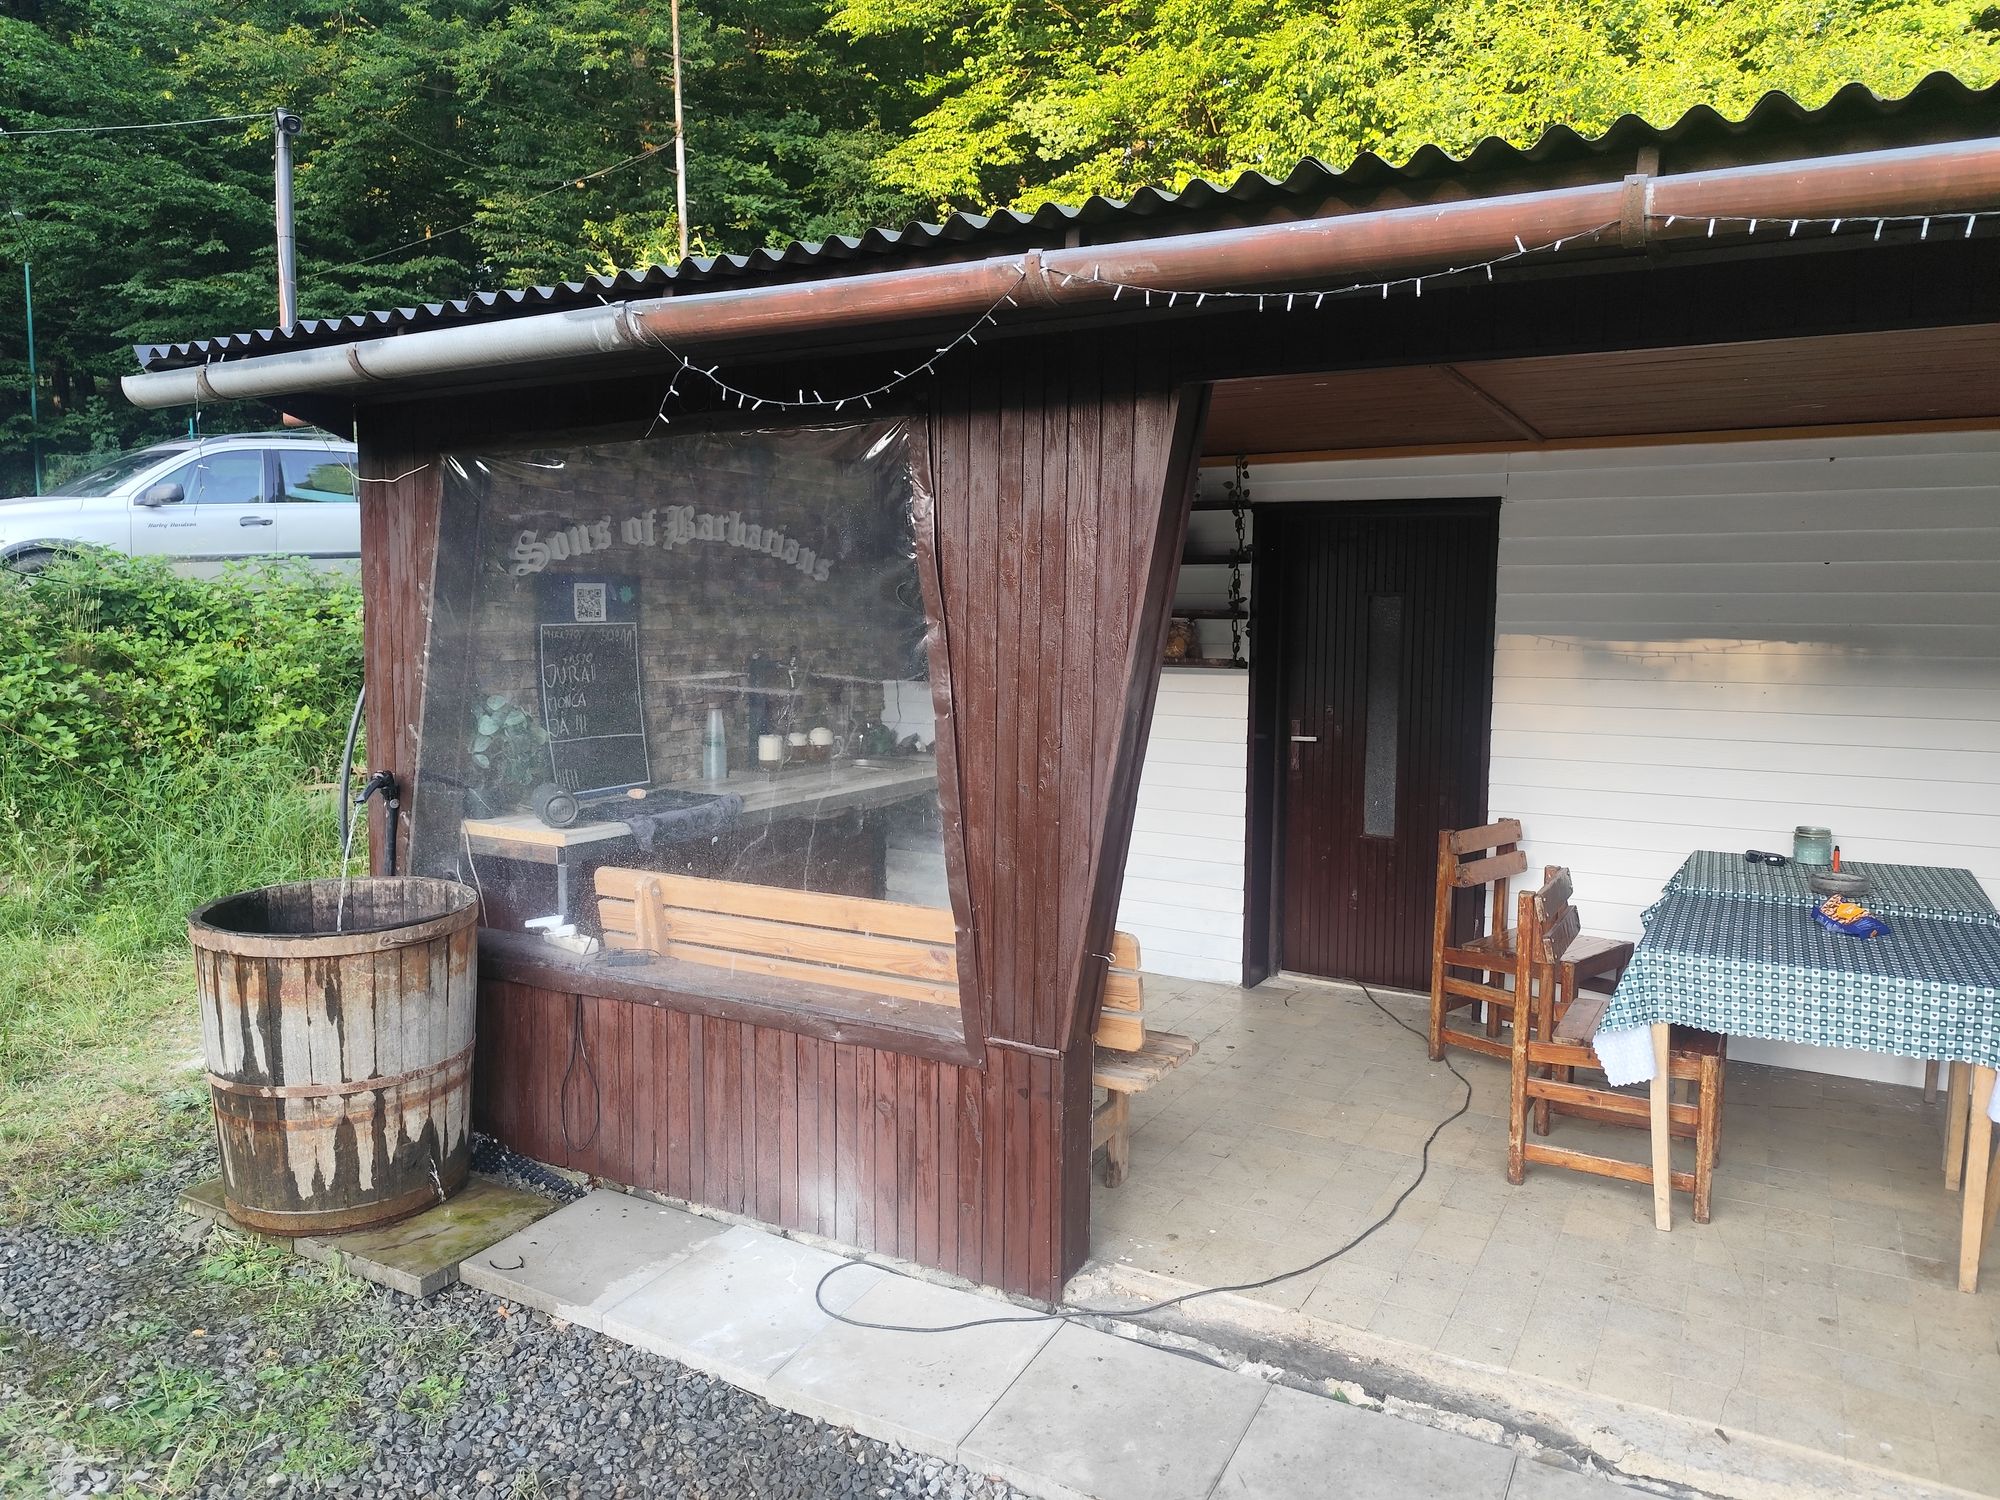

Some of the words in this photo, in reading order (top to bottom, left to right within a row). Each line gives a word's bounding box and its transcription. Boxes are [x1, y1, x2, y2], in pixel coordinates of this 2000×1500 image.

[513, 515, 612, 576] Sons
[620, 508, 658, 547] of
[662, 504, 834, 582] Barbarians
